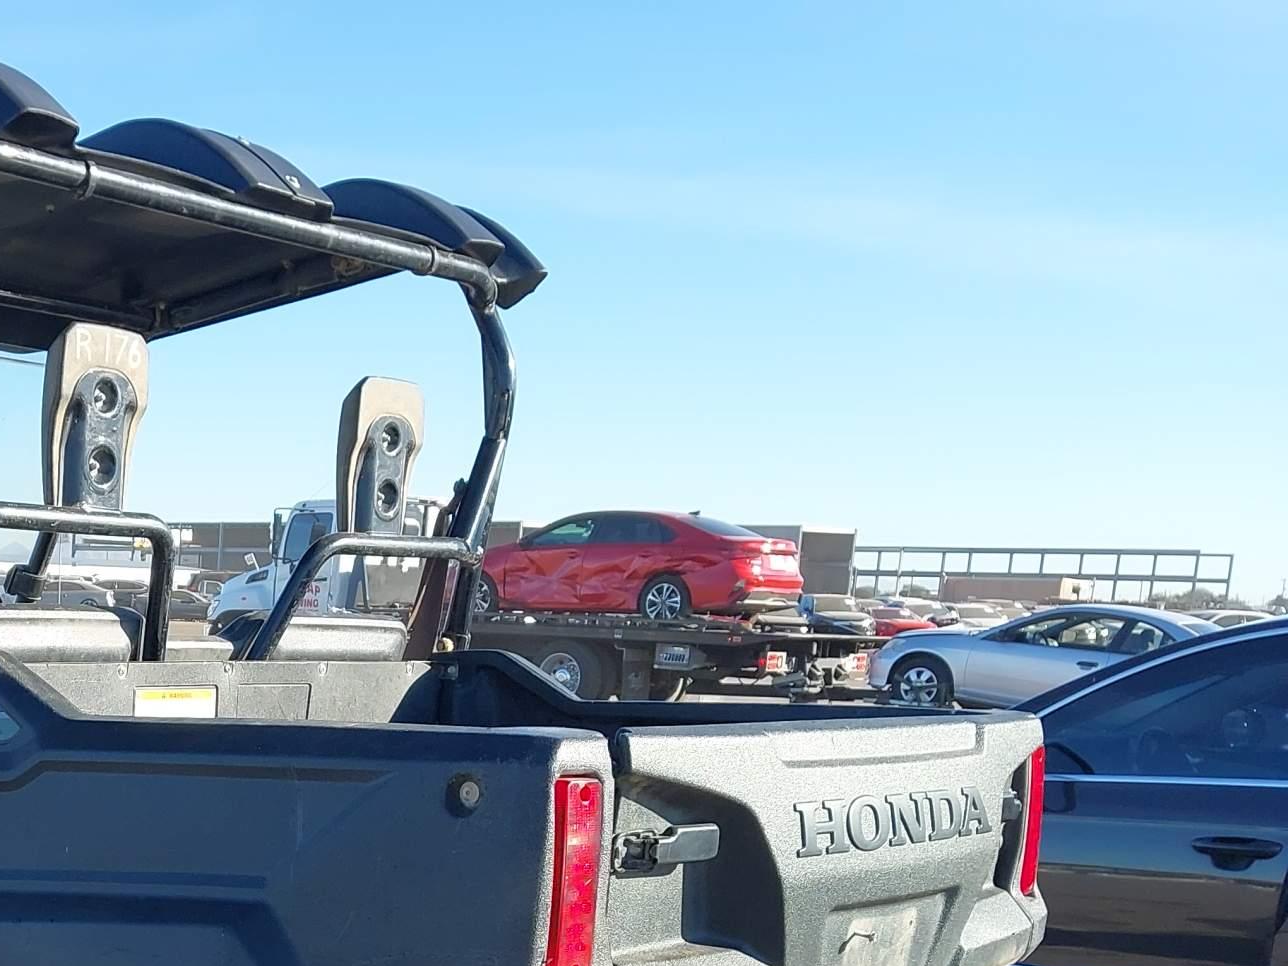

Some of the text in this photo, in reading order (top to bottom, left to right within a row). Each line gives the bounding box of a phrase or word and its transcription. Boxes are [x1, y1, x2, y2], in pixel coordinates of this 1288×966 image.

[76, 327, 142, 369] R 176
[793, 785, 993, 858] HONDA
